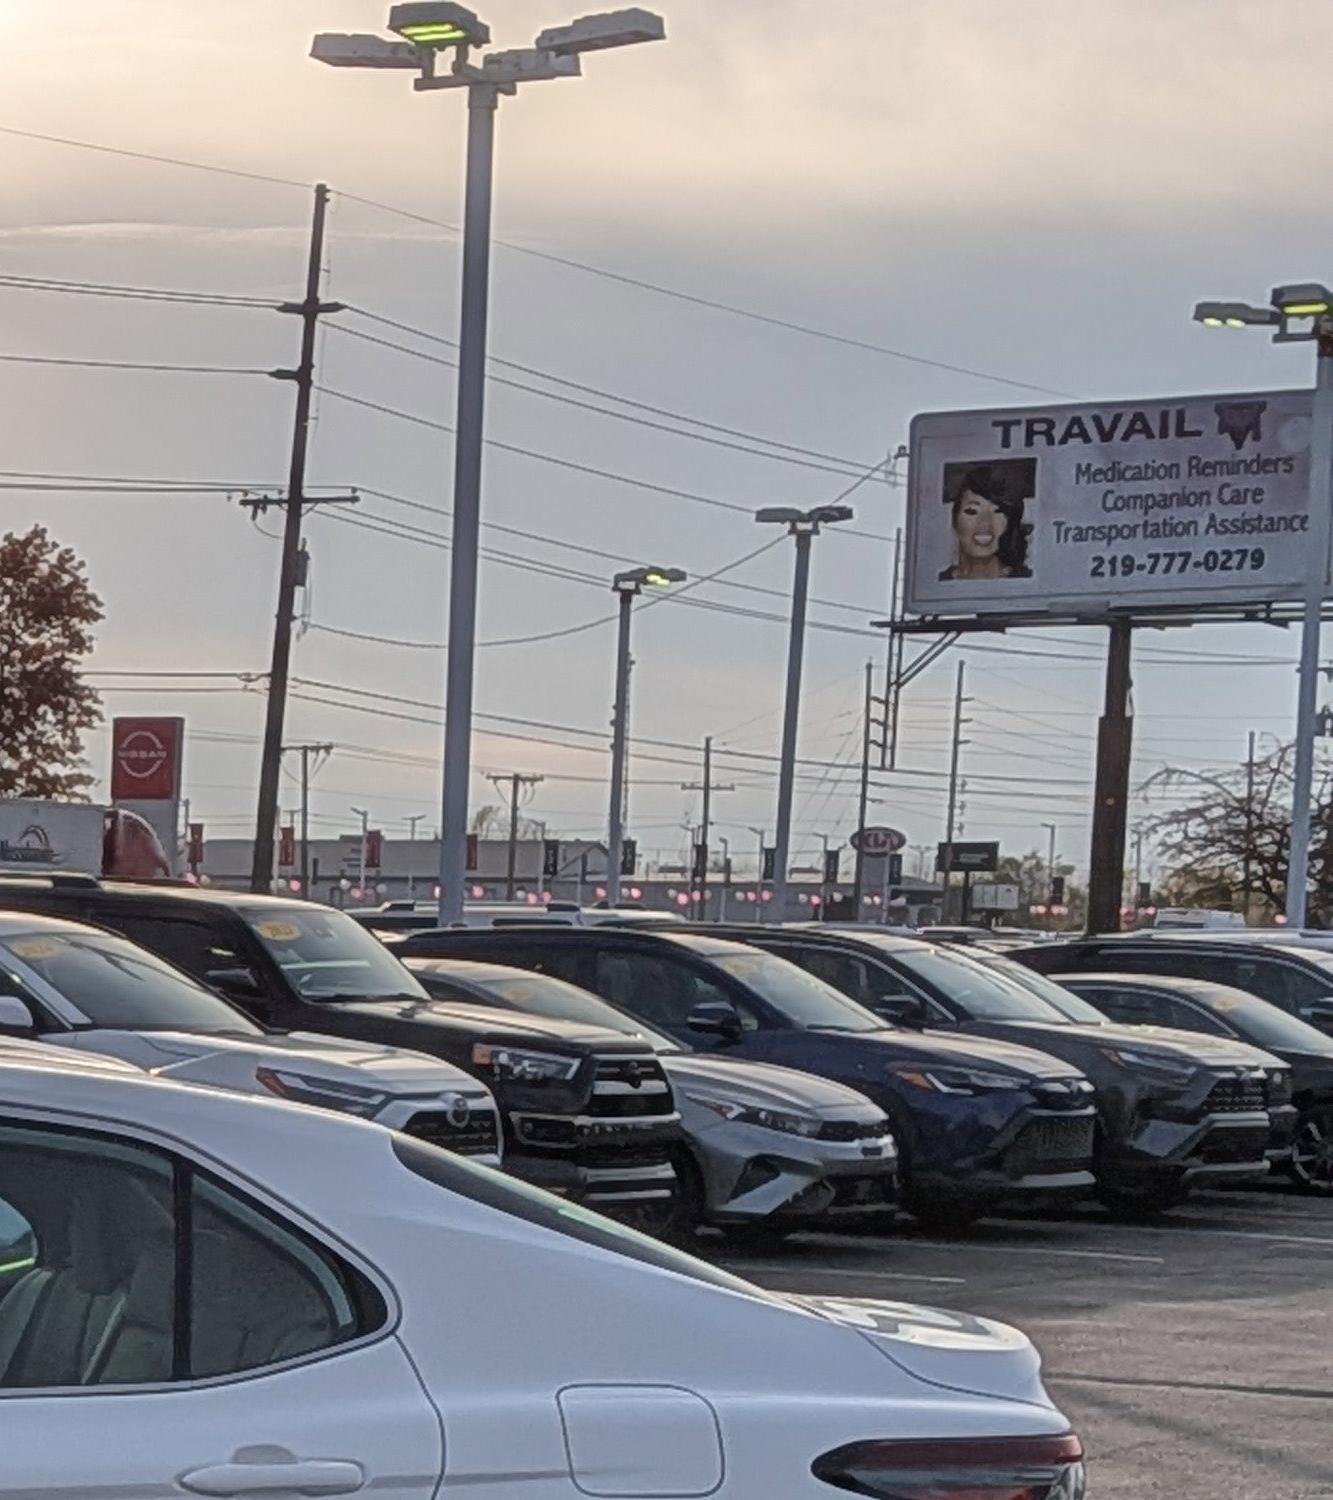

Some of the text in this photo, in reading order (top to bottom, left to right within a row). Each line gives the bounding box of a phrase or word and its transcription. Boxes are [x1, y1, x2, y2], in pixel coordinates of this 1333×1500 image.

[991, 408, 1203, 448] TRAVAIL
[1075, 453, 1294, 484] Medication Reminders
[1101, 482, 1264, 516] Companion Care
[1053, 511, 1309, 546] Transportation Assistance
[1090, 547, 1265, 577] 219-777-0279
